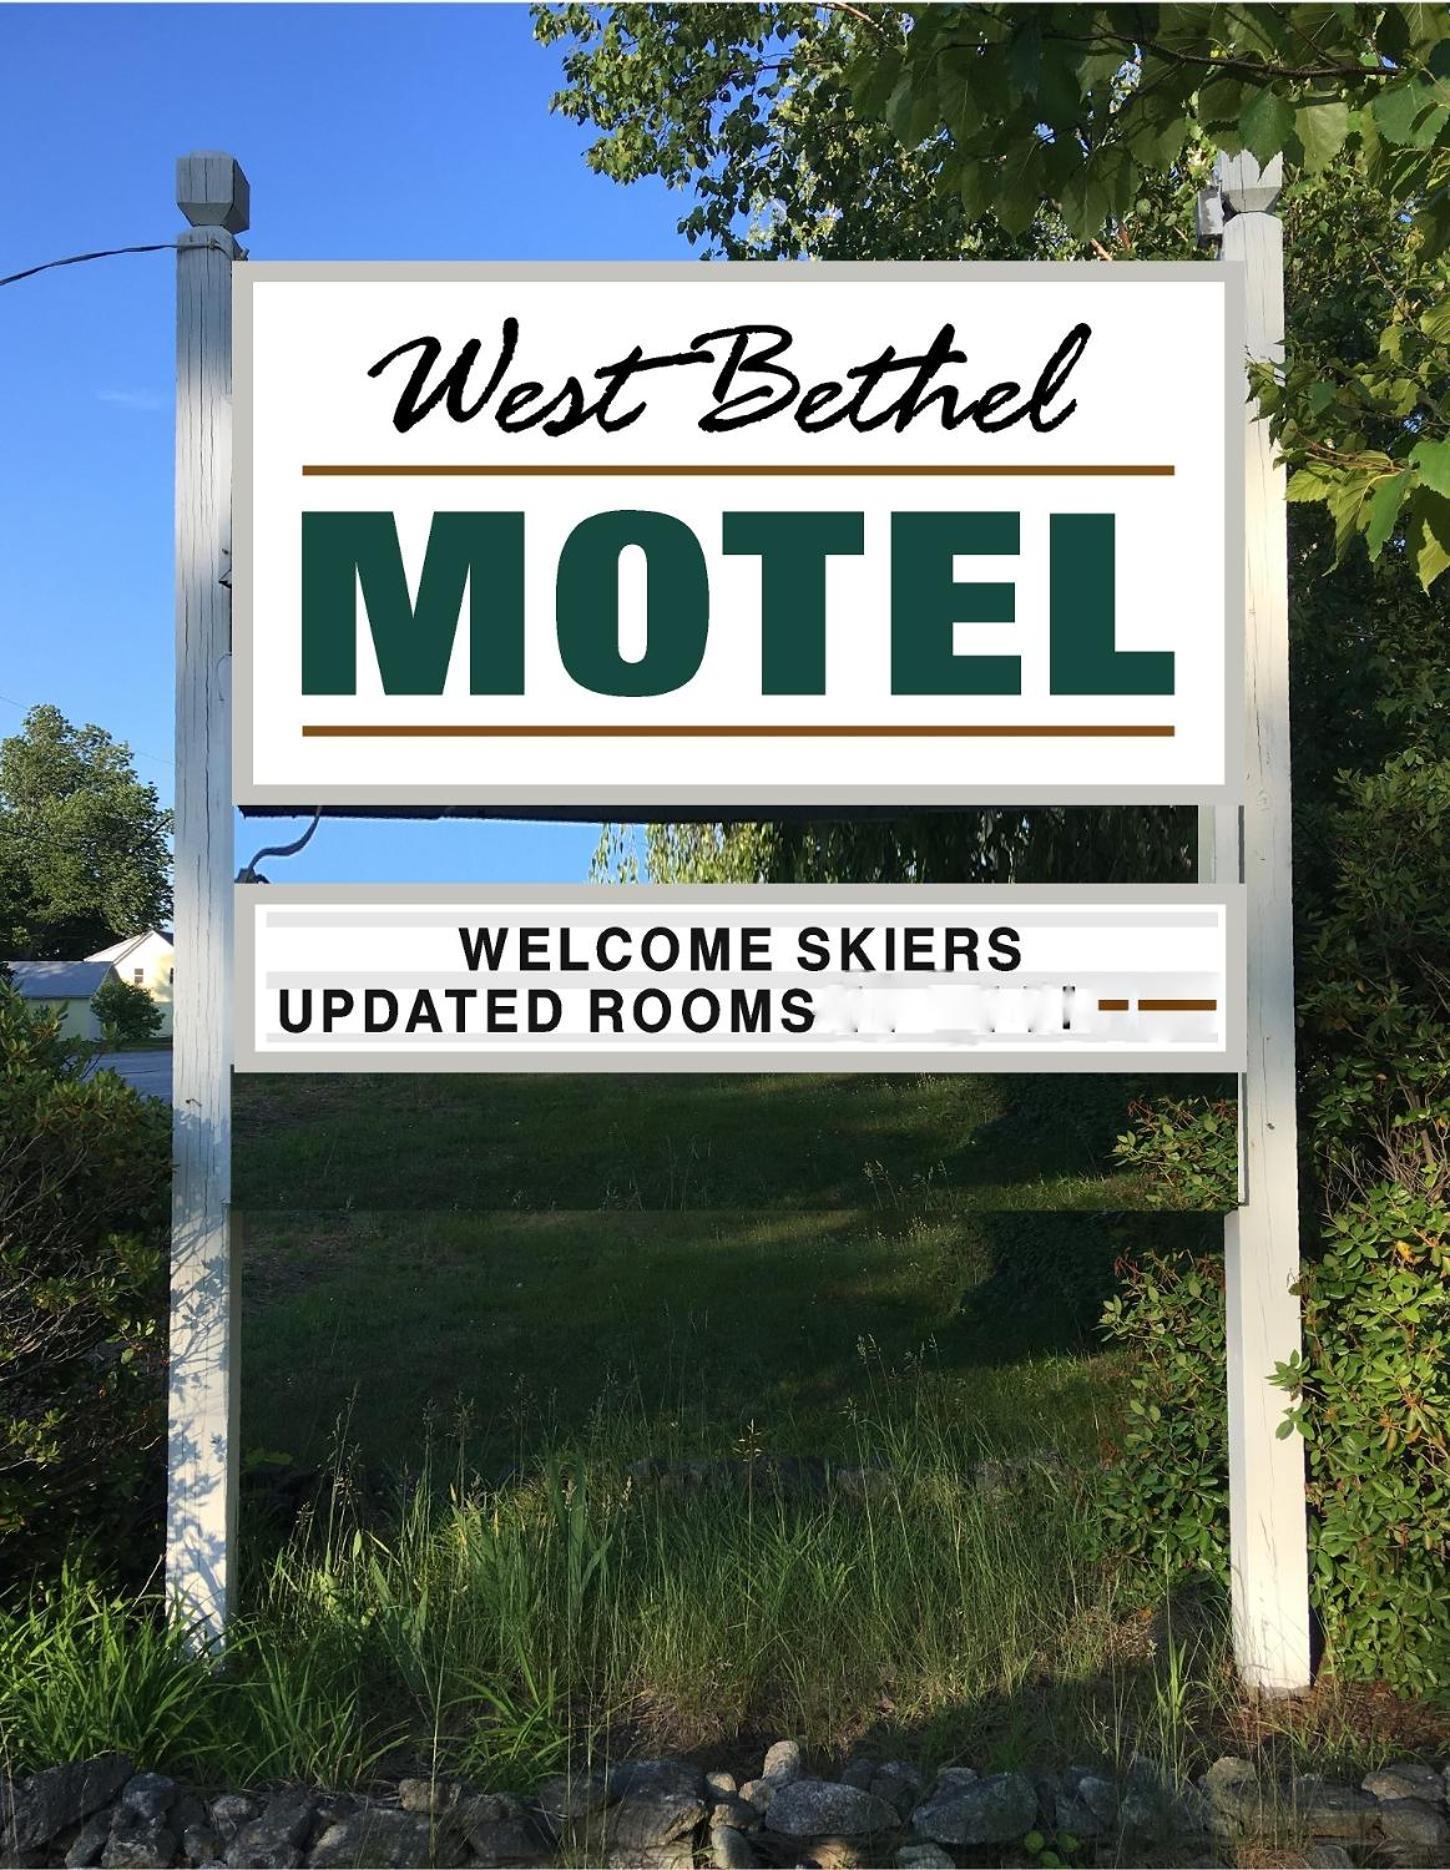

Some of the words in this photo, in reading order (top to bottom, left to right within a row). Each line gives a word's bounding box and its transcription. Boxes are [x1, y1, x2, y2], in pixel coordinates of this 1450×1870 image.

[368, 318, 712, 437] West
[690, 323, 1091, 433] Bethel
[302, 510, 1174, 697] MOTEL
[459, 927, 771, 971] WELCOME
[798, 927, 1021, 970] SKIERS
[280, 990, 561, 1033] UPDATED
[591, 988, 815, 1033] ROOMS
